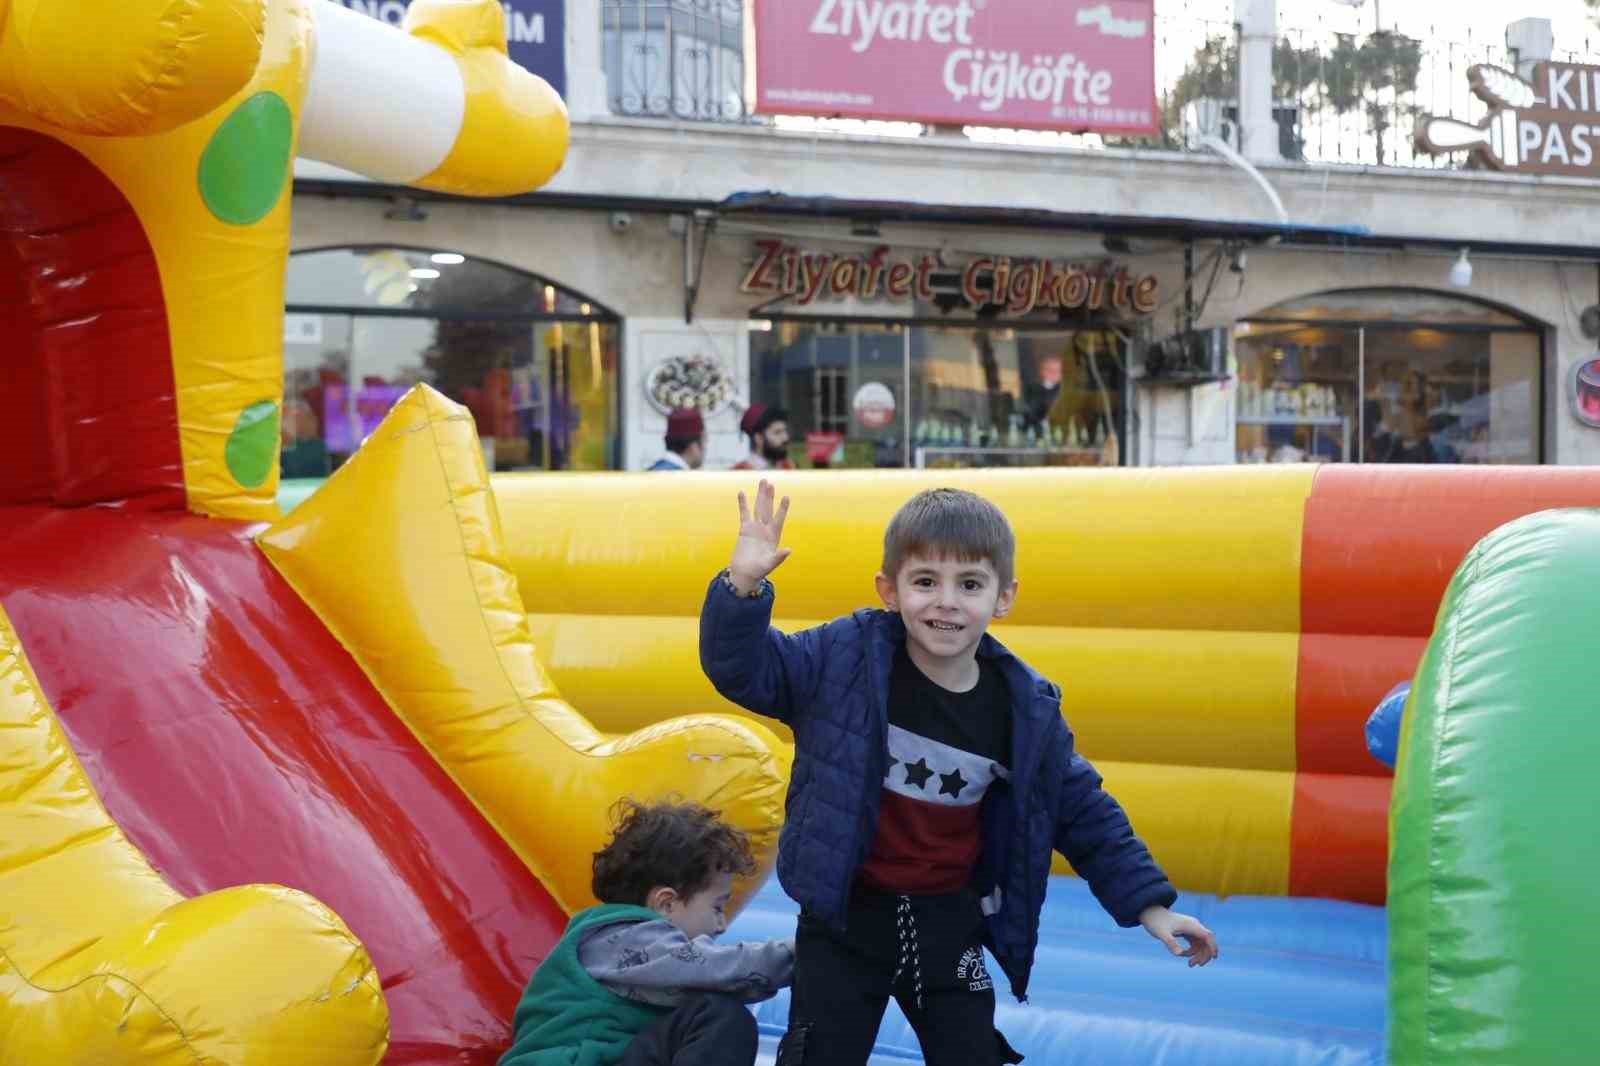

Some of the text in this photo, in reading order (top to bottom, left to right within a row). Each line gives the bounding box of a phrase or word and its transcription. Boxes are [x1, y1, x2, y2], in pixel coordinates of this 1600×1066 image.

[809, 0, 976, 53] Ziyafet
[943, 48, 1113, 111] Çiğköfte
[741, 239, 936, 305] Ziyafet
